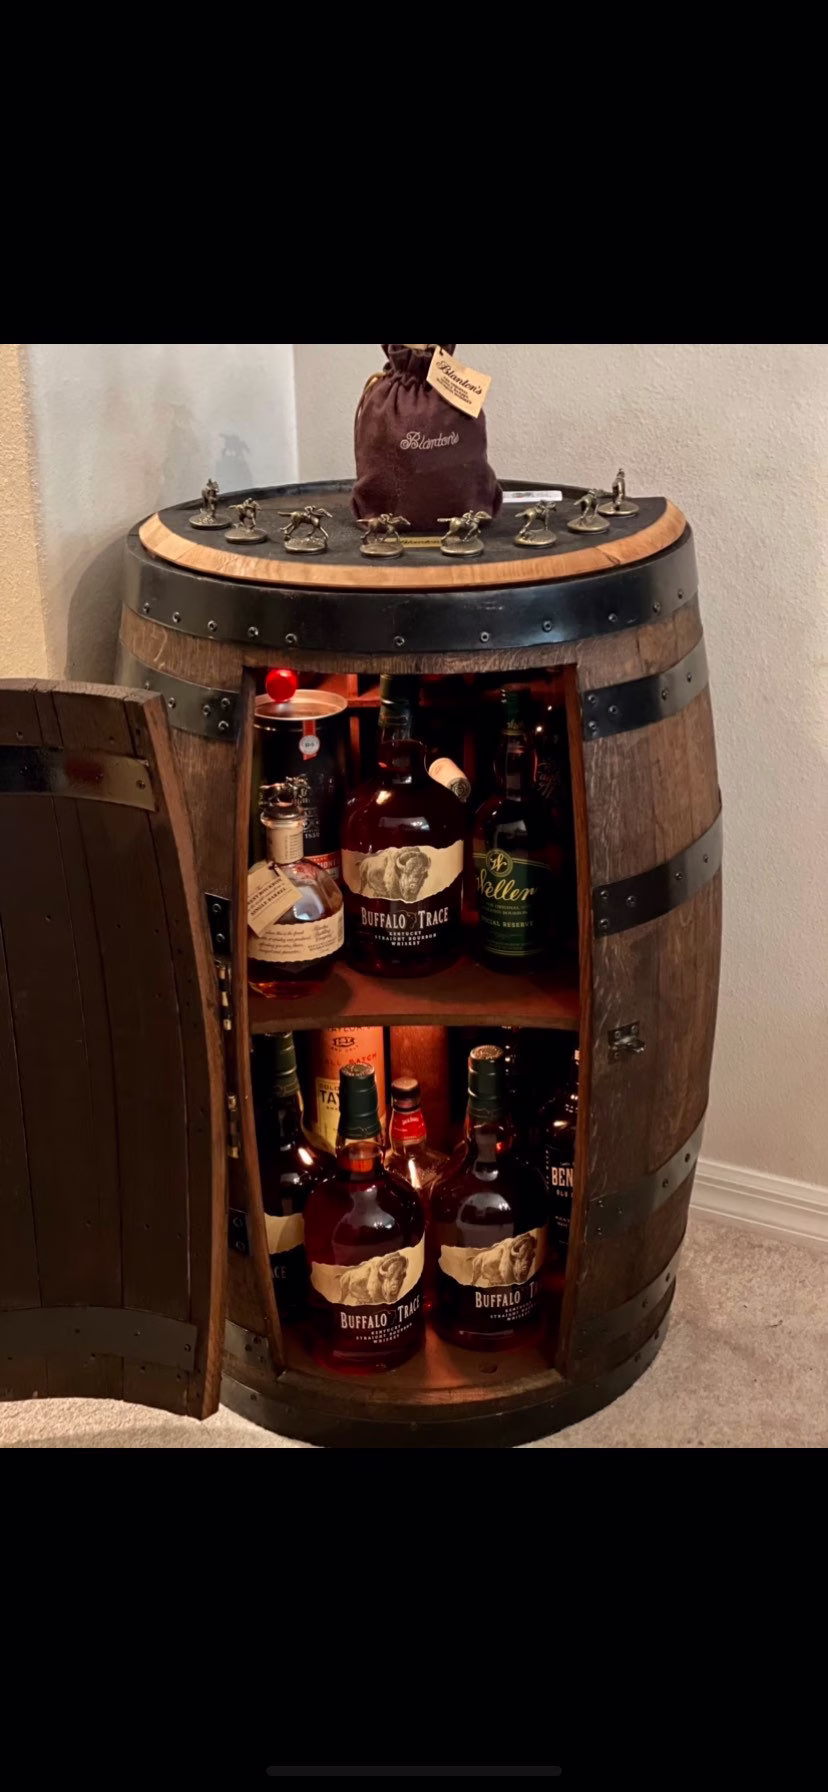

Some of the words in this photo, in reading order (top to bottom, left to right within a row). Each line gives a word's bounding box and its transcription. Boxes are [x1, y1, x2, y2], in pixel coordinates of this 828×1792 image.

[436, 360, 483, 395] Blanton's
[399, 430, 460, 450] Blanton's
[475, 868, 539, 901] Weller
[361, 907, 406, 929] BUFFALO
[418, 907, 449, 929] TRACE
[551, 1166, 574, 1187] BEN
[475, 1290, 521, 1308] BUFFALO
[340, 1311, 387, 1329] BUFFALO
[397, 1294, 420, 1322] TRACE
